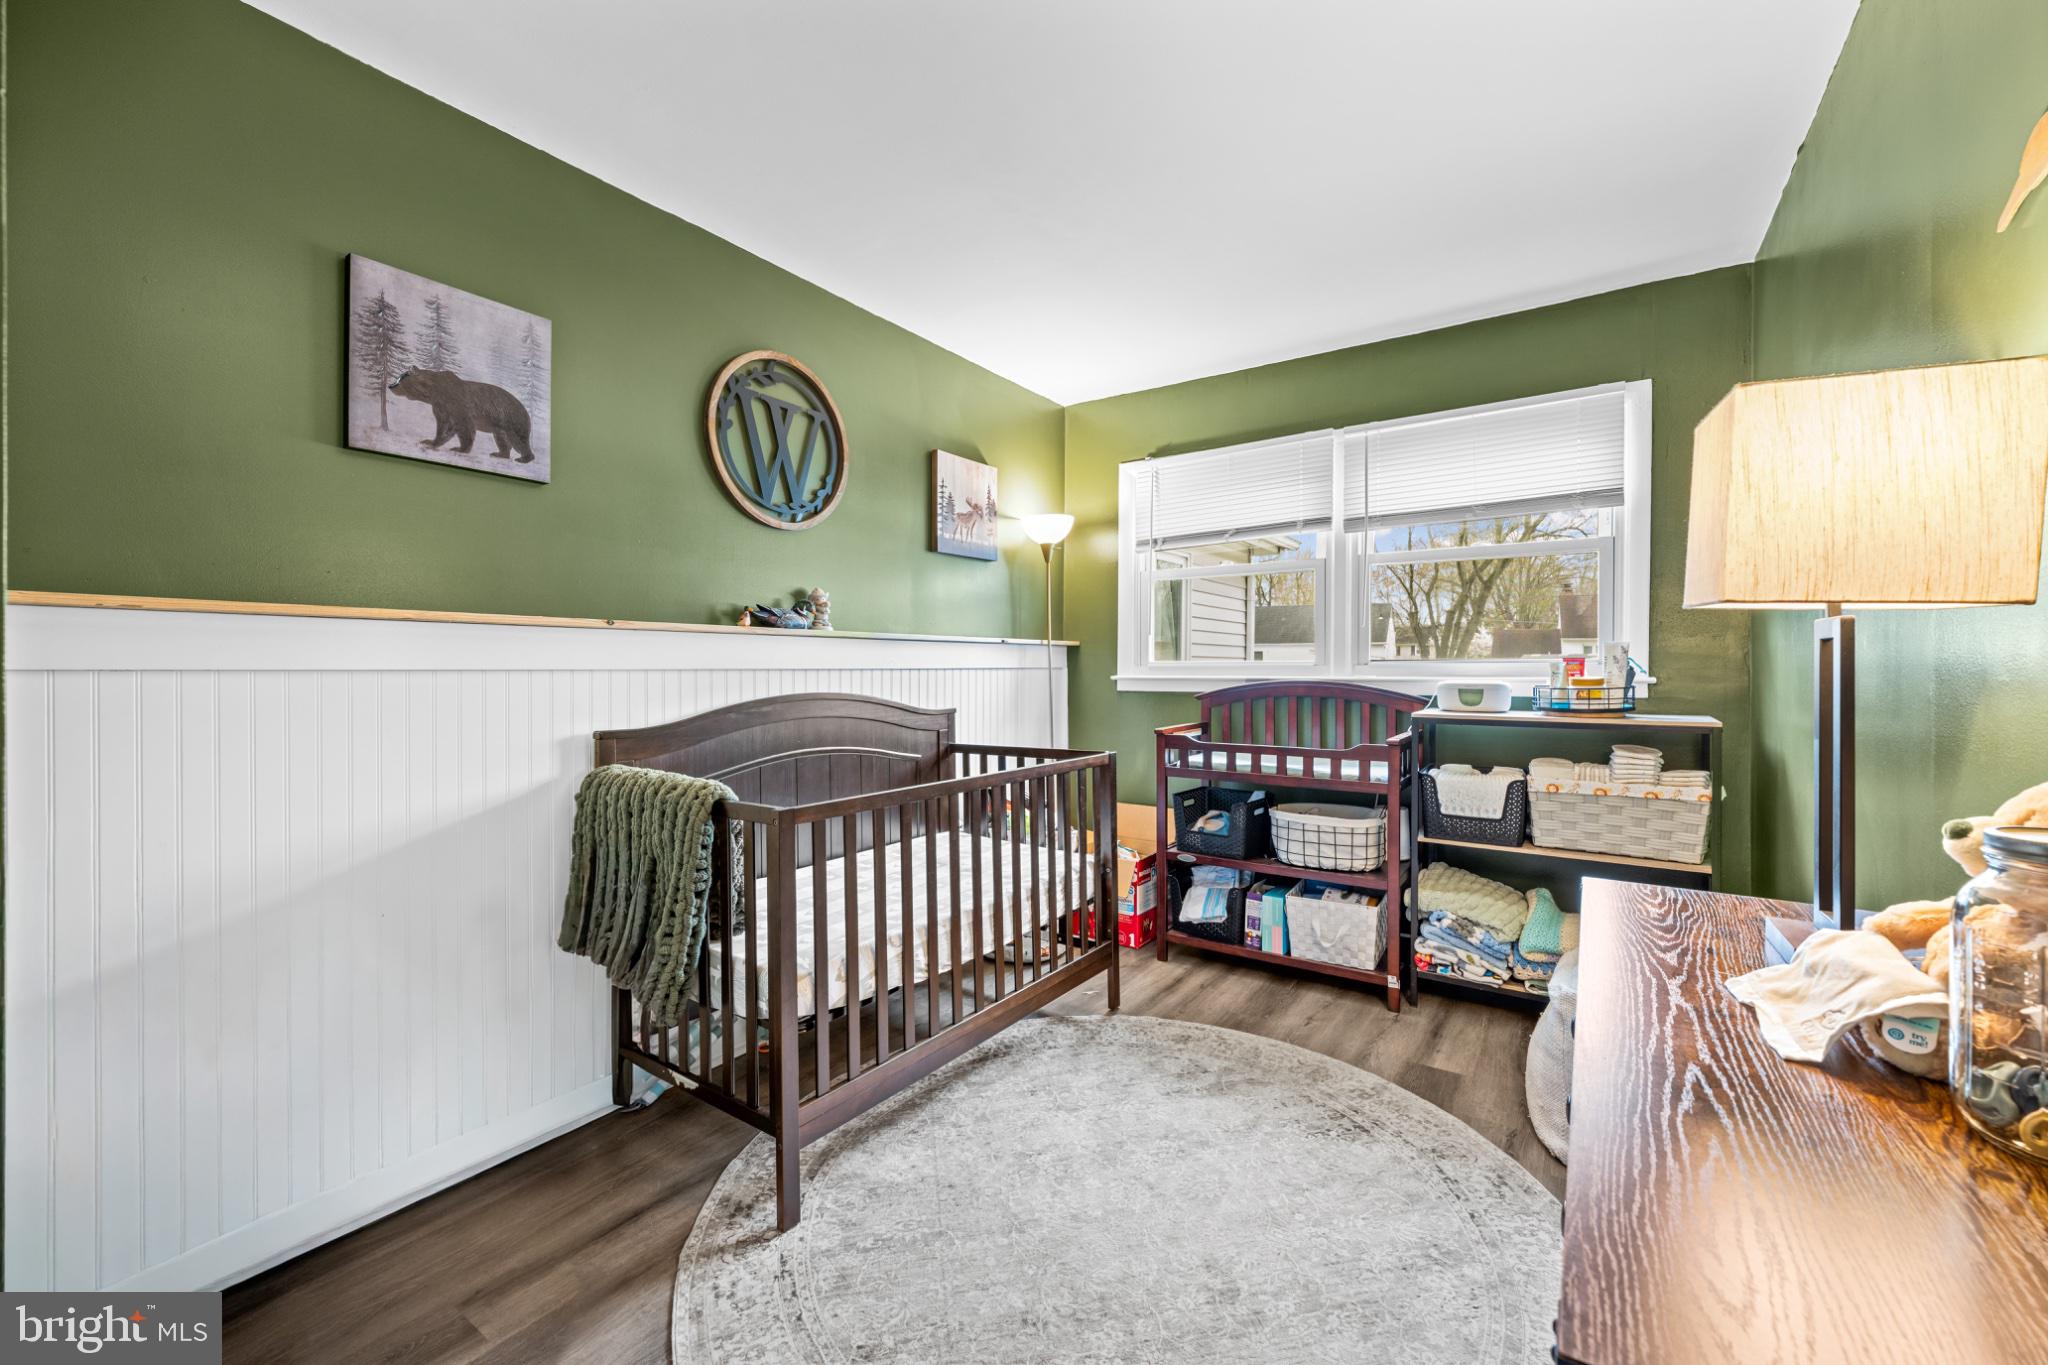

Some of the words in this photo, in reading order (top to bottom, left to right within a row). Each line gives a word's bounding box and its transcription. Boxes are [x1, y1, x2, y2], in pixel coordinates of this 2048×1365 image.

[735, 387, 828, 508] W
[1128, 933, 1136, 948] 1
[1911, 1032, 1928, 1042] try
